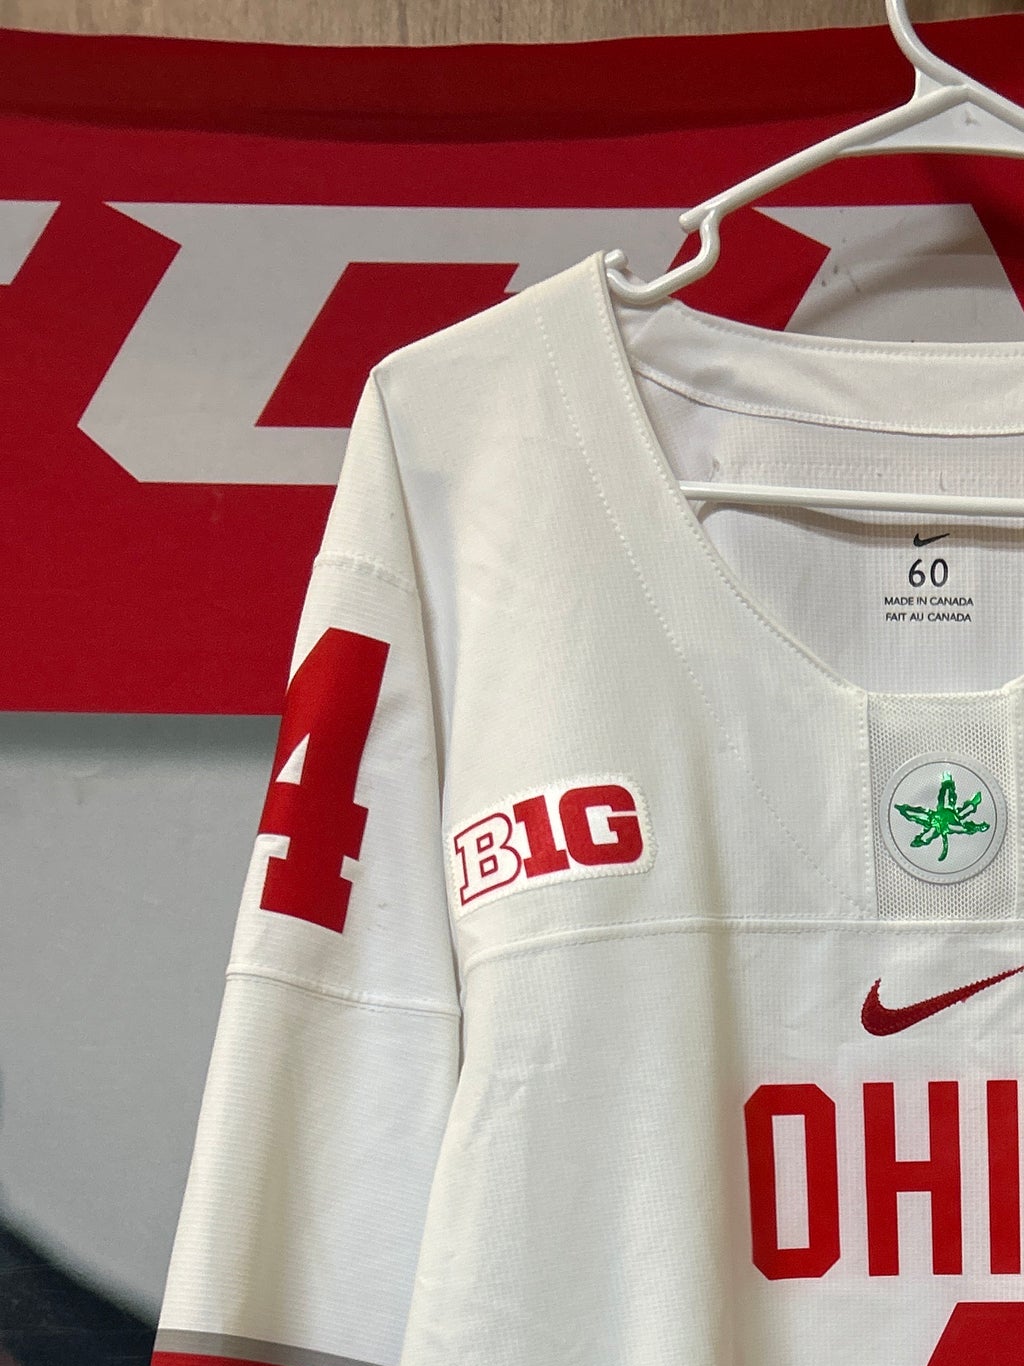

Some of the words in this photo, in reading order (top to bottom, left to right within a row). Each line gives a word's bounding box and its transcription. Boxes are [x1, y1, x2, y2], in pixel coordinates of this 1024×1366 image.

[908, 558, 949, 588] 60
[884, 596, 914, 606] MADE
[916, 596, 928, 606] IN
[929, 597, 975, 607] CANADA
[885, 612, 907, 622] FAIT
[909, 612, 925, 622] AU
[927, 612, 973, 623] CANADA
[257, 627, 391, 934] 4
